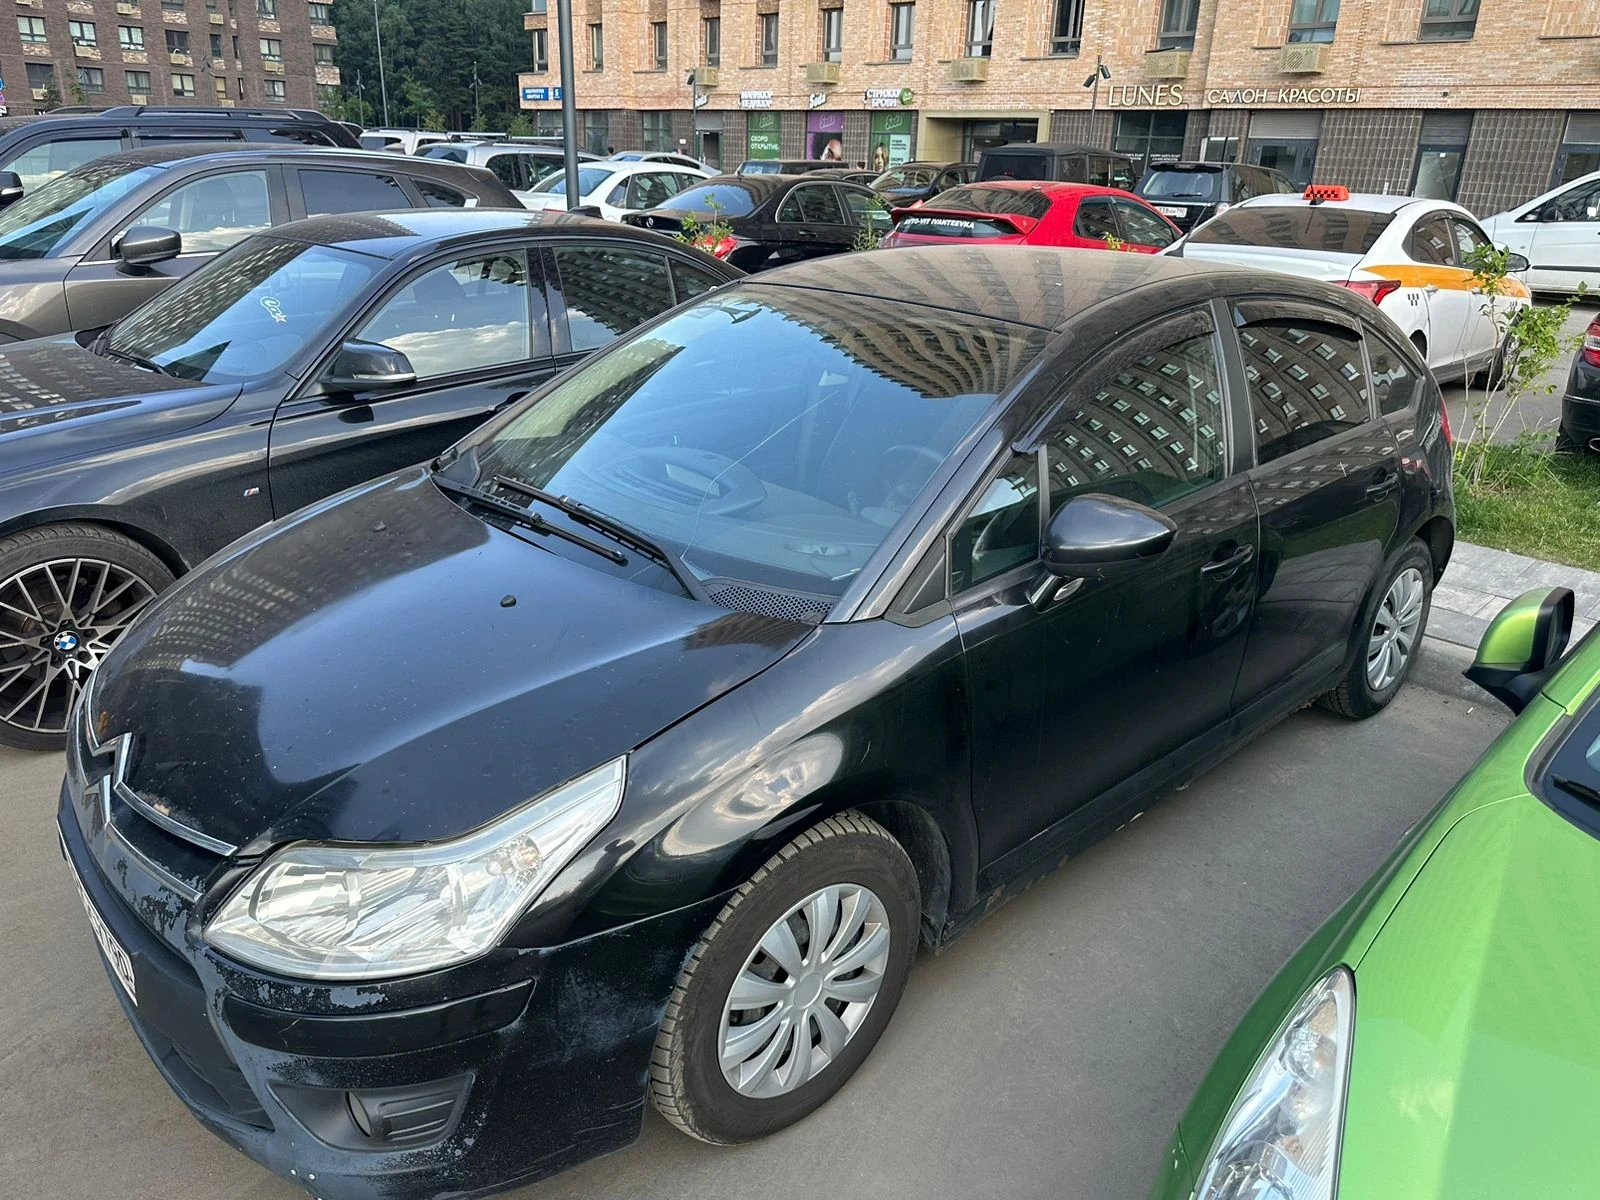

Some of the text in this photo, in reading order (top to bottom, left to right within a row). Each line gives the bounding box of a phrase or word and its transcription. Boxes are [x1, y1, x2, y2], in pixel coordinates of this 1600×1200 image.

[1107, 84, 1183, 107] LUNES
[1207, 87, 1363, 104] САЛОН КРАСОТЫ
